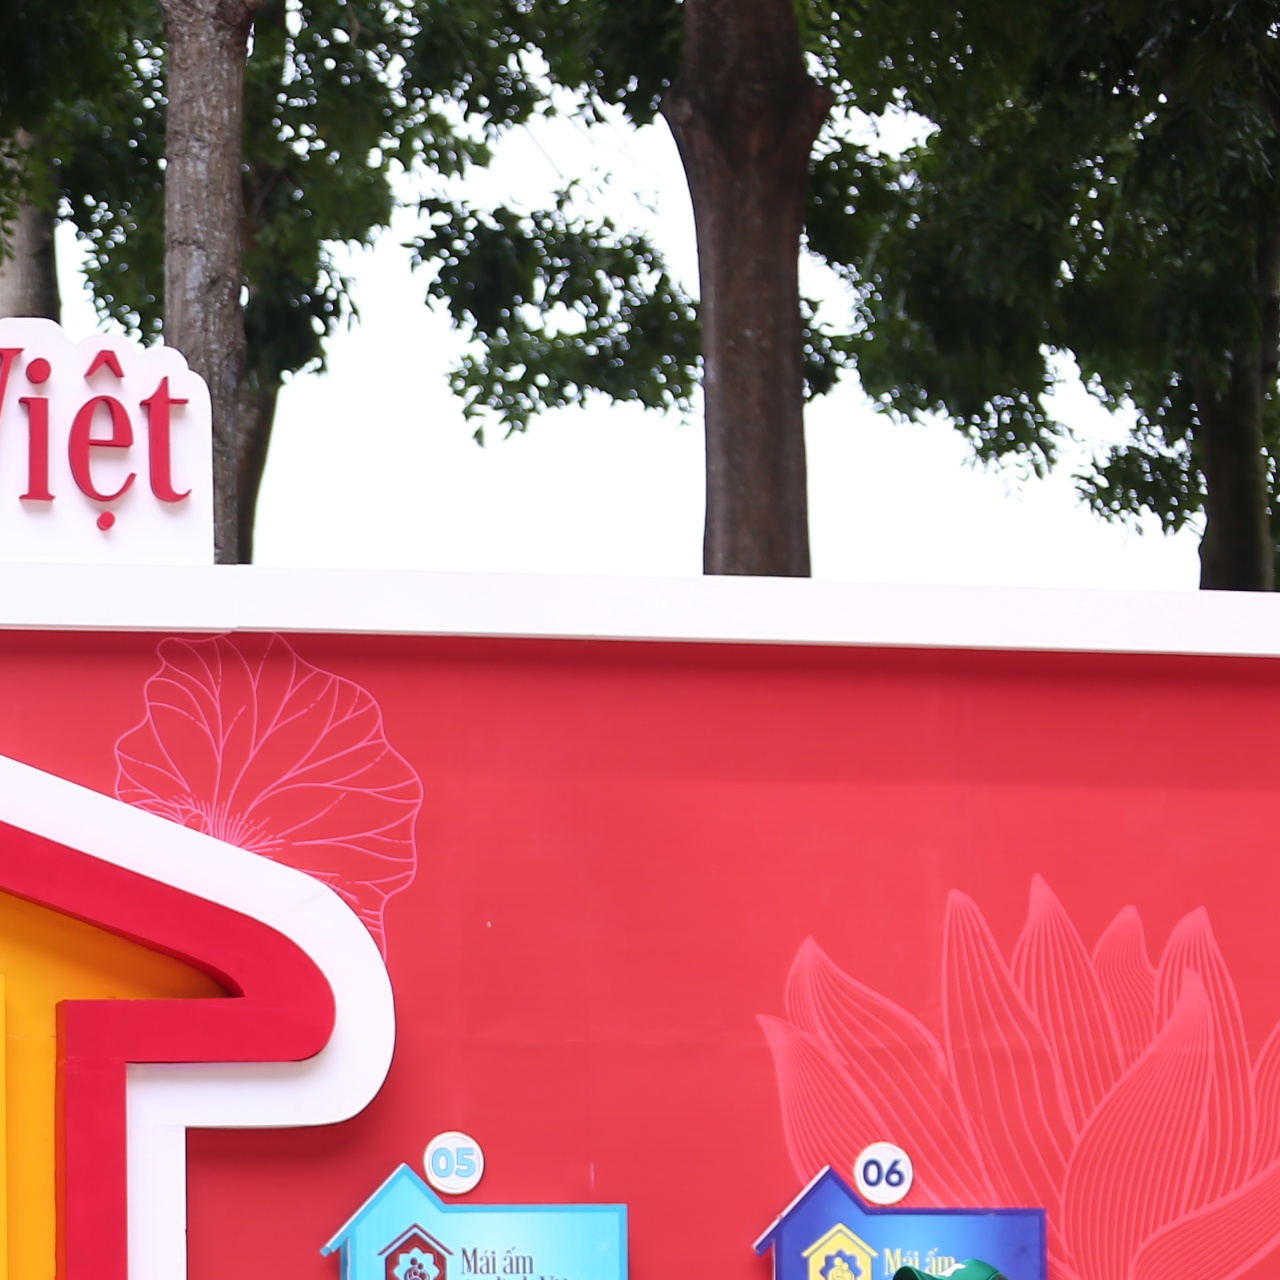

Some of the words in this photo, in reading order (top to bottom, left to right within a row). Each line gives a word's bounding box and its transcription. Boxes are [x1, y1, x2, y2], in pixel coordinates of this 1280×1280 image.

[431, 1147, 477, 1178] 05
[862, 1158, 906, 1188] 06
[461, 1247, 497, 1275] Mái
[502, 1246, 534, 1275] ấm
